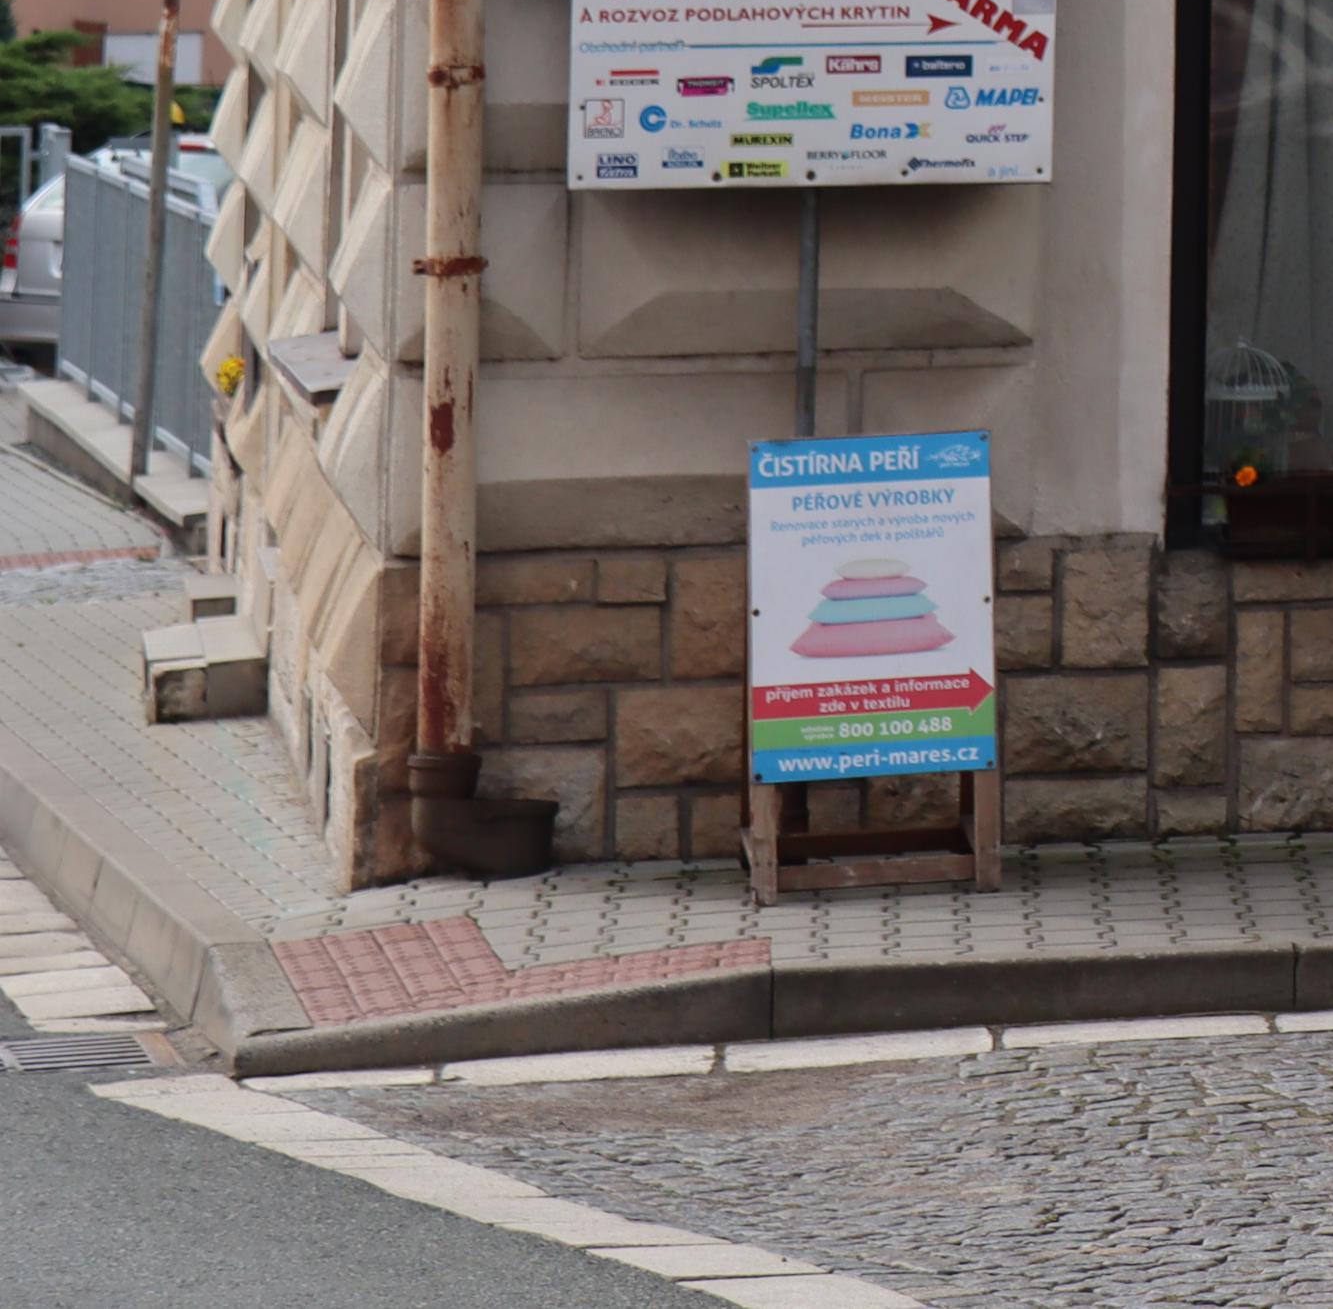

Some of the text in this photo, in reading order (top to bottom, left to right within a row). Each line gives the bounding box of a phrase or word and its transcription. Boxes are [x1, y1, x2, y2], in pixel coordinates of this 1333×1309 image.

[581, 3, 911, 23] A ROZVOZ PODLAHOVÝCH KRYTIN
[828, 58, 880, 72] Kährs
[751, 75, 815, 89] SPOLTEX
[975, 88, 1039, 106] MAPEI
[732, 135, 793, 145] MUREXIN
[850, 123, 902, 139] Bona
[599, 155, 636, 164] LINO
[850, 150, 887, 159] FLOOR
[758, 445, 921, 478] ČISTÍRNA PEŘÍ
[869, 488, 955, 508] VÝROBKY
[765, 676, 970, 703] příjem zakázek a informace
[819, 695, 911, 714] zde v textilu
[839, 722, 874, 738] 800
[880, 719, 913, 736] 100
[918, 716, 953, 734] 488
[778, 746, 979, 773] www.peri-mares.cz
